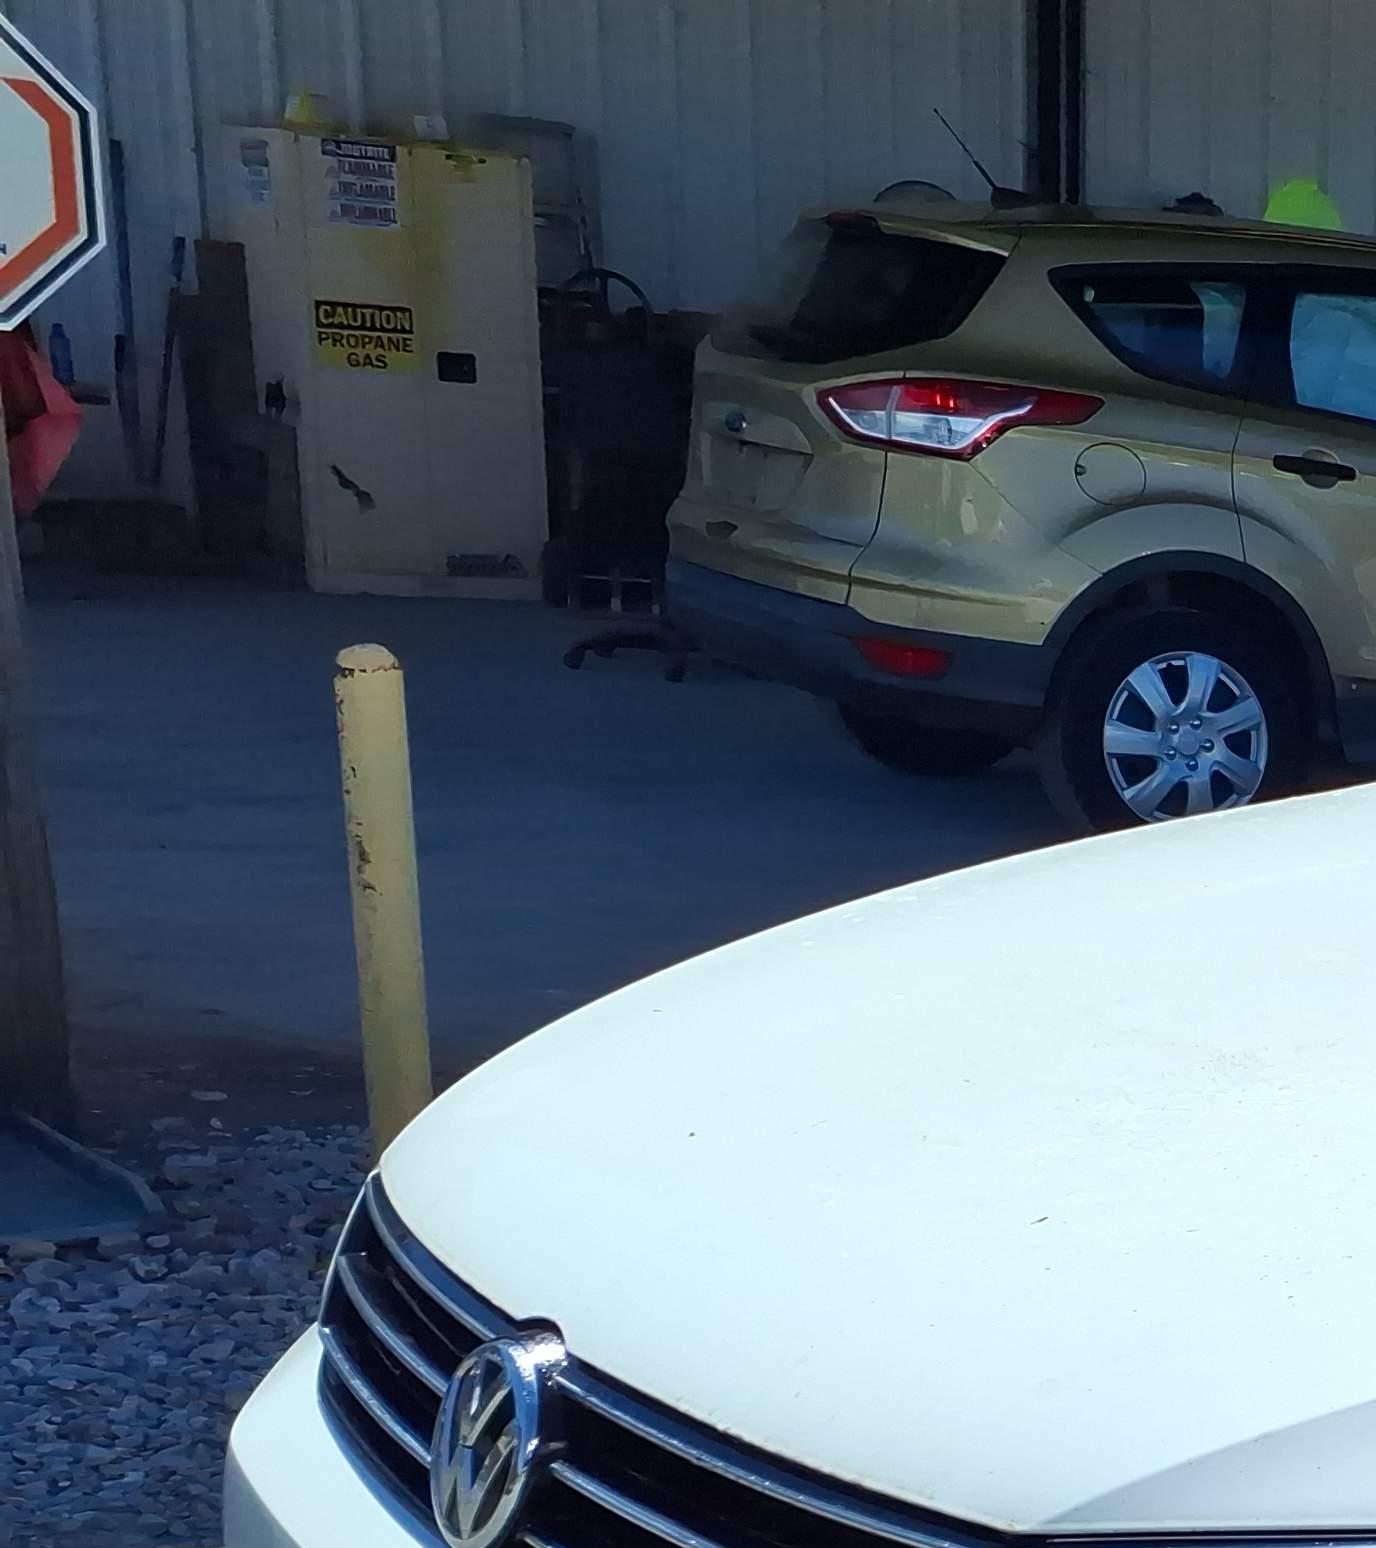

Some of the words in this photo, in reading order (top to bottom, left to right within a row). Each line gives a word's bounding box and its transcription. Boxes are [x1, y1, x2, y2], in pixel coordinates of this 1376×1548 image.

[319, 305, 411, 330] CAUTION
[318, 331, 414, 353] PROPANE
[347, 352, 389, 369] GAS
